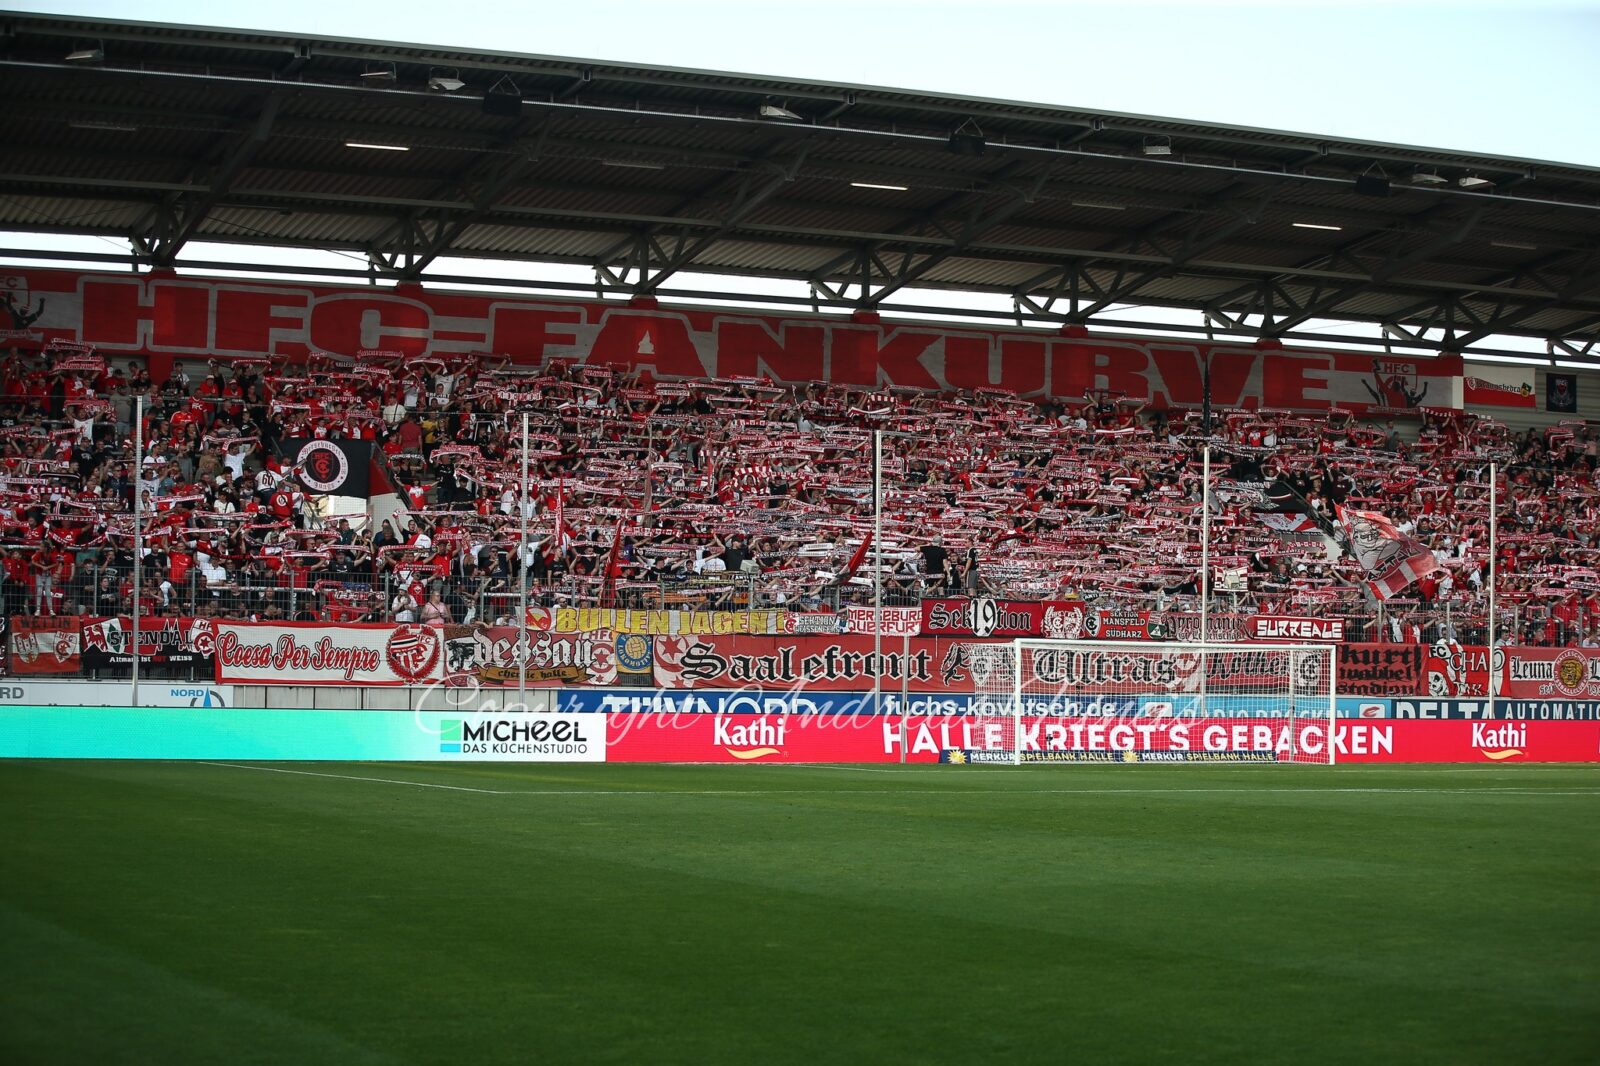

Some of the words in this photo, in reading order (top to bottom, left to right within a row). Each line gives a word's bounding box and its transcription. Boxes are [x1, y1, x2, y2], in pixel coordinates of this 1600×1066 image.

[1384, 363, 1409, 373] HFC
[677, 610, 768, 635] JAGEN
[1105, 629, 1142, 638] SÜDHARZ
[1257, 619, 1343, 639] SURREALE
[217, 631, 273, 667] Coesa
[273, 633, 311, 670] Per
[311, 636, 381, 680] Sempre
[473, 629, 595, 669] Dessau
[680, 642, 932, 682] Saalefront
[1510, 655, 1553, 680] Leuna
[170, 688, 204, 698] NORD
[886, 695, 1115, 717] fuchs-kovatsch.de
[713, 717, 785, 746] Kathi
[882, 723, 1004, 754] HALLE
[1203, 725, 1393, 755] GEBACKEN
[1472, 722, 1527, 748] Kathi
[463, 743, 487, 754] DAS
[492, 742, 588, 754] KÜCHENSTUDIO
[970, 753, 1015, 761] MERKUR
[1020, 753, 1077, 761] SPIELBANK
[1080, 753, 1114, 761] HALLE
[1142, 753, 1185, 761] MERKUR
[1187, 753, 1241, 761] SPIELBANK
[1243, 753, 1274, 761] HALLE
